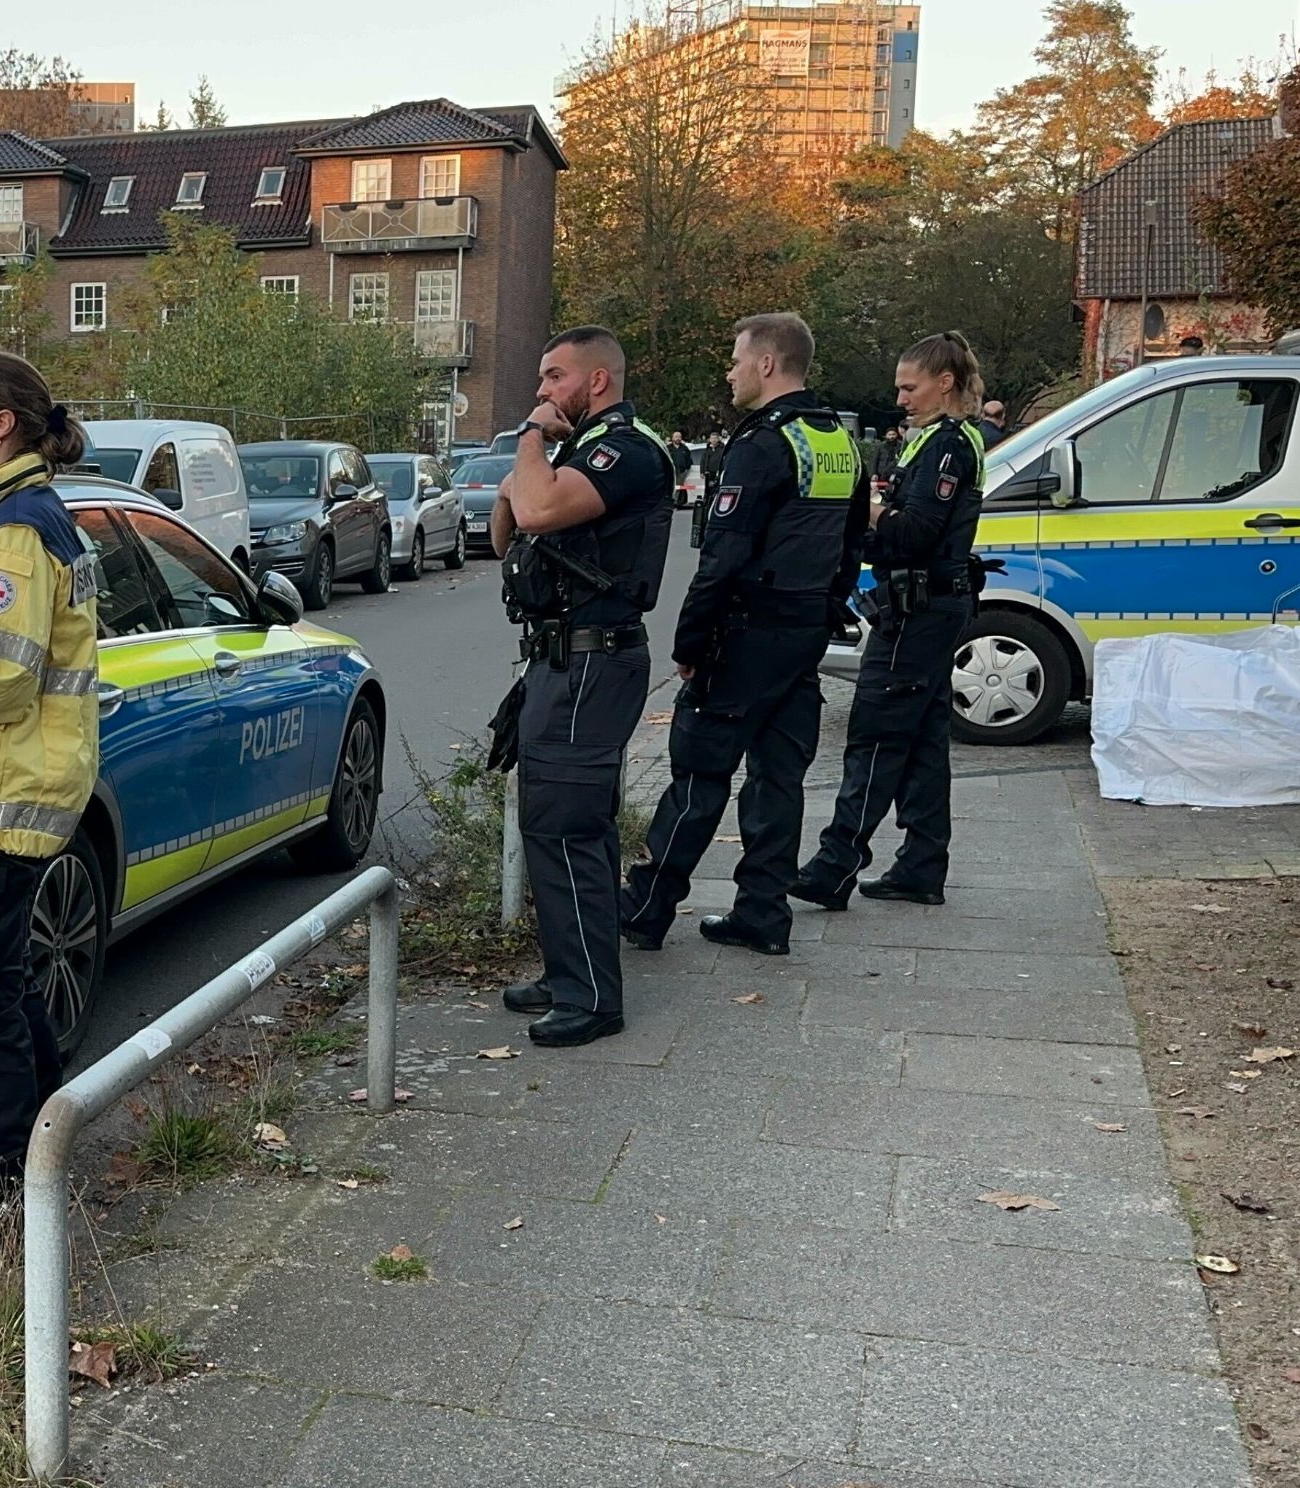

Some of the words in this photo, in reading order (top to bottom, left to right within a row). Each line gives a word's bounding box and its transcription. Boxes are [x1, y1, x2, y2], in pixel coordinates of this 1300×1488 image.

[762, 39, 807, 48] HAGMANS
[815, 452, 853, 474] POLIZEI
[239, 705, 305, 765] POLIZEI
